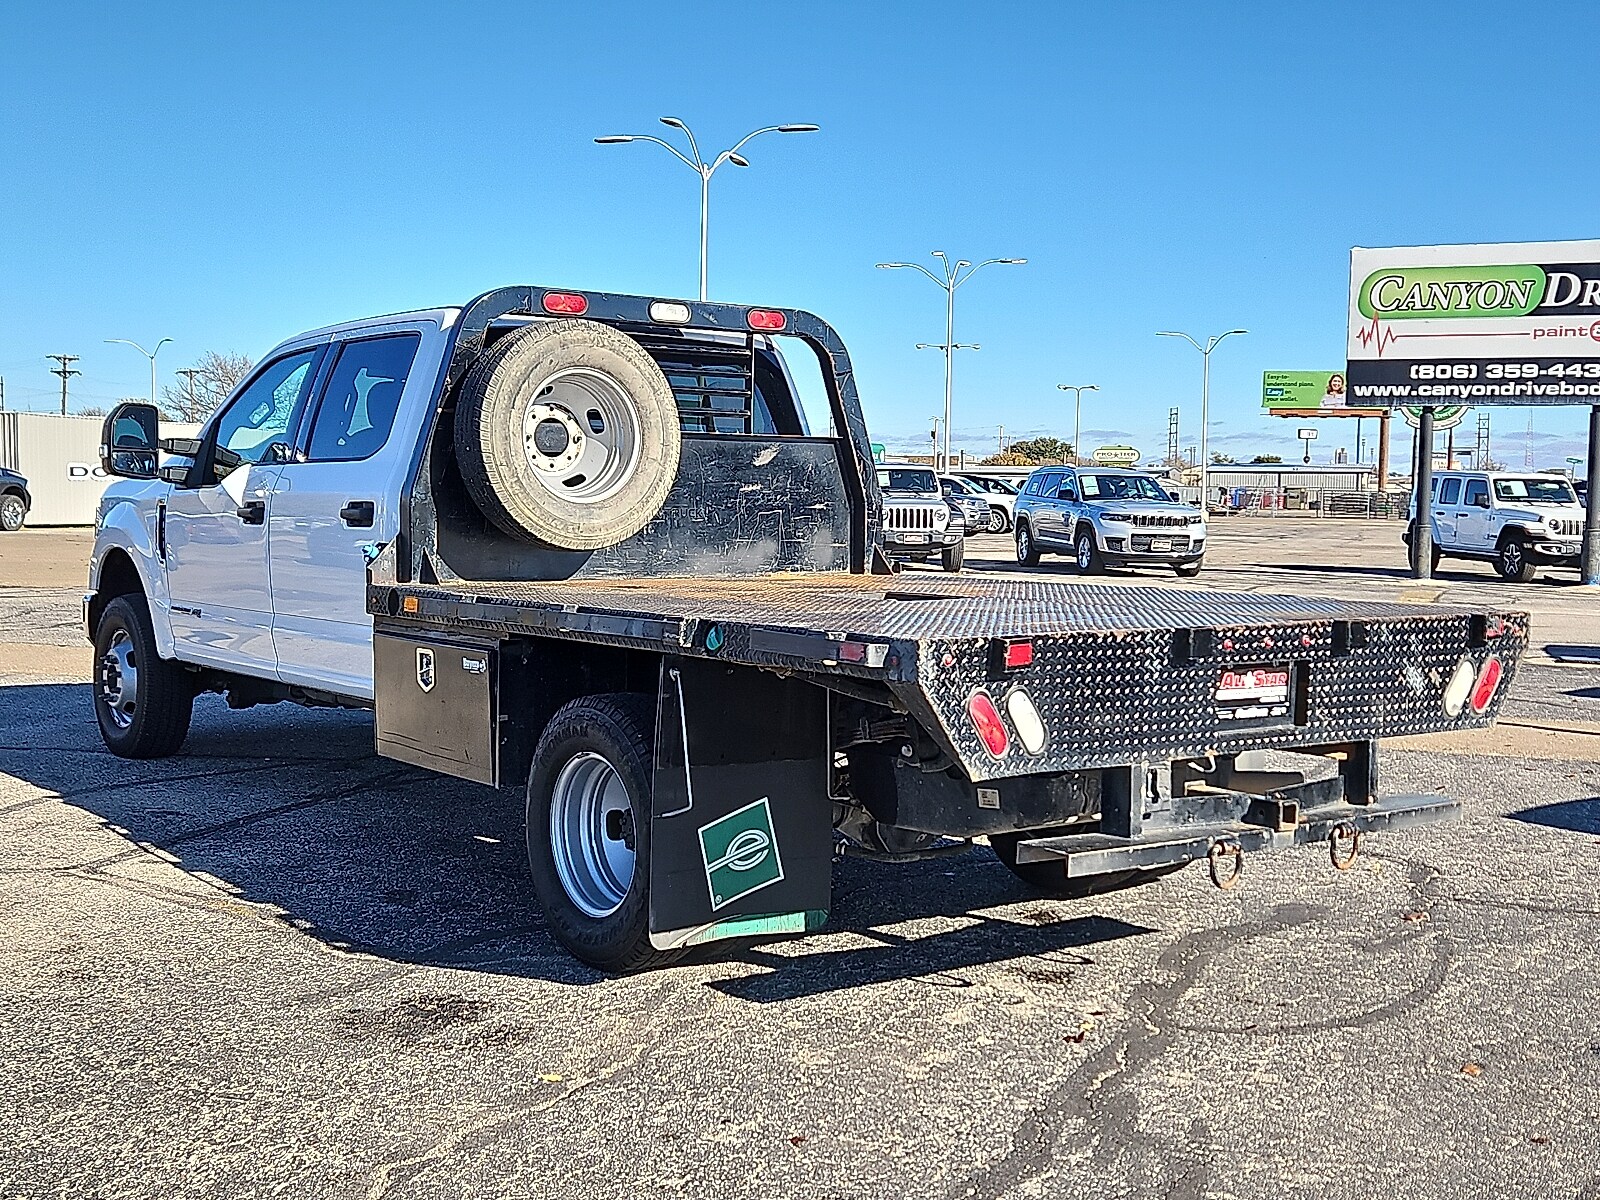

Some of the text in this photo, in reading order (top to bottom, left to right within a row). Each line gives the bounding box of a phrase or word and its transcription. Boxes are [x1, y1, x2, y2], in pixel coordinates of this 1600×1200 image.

[1369, 275, 1536, 311] CANYON
[1533, 325, 1588, 339] paint
[1409, 364, 1478, 379] (806)
